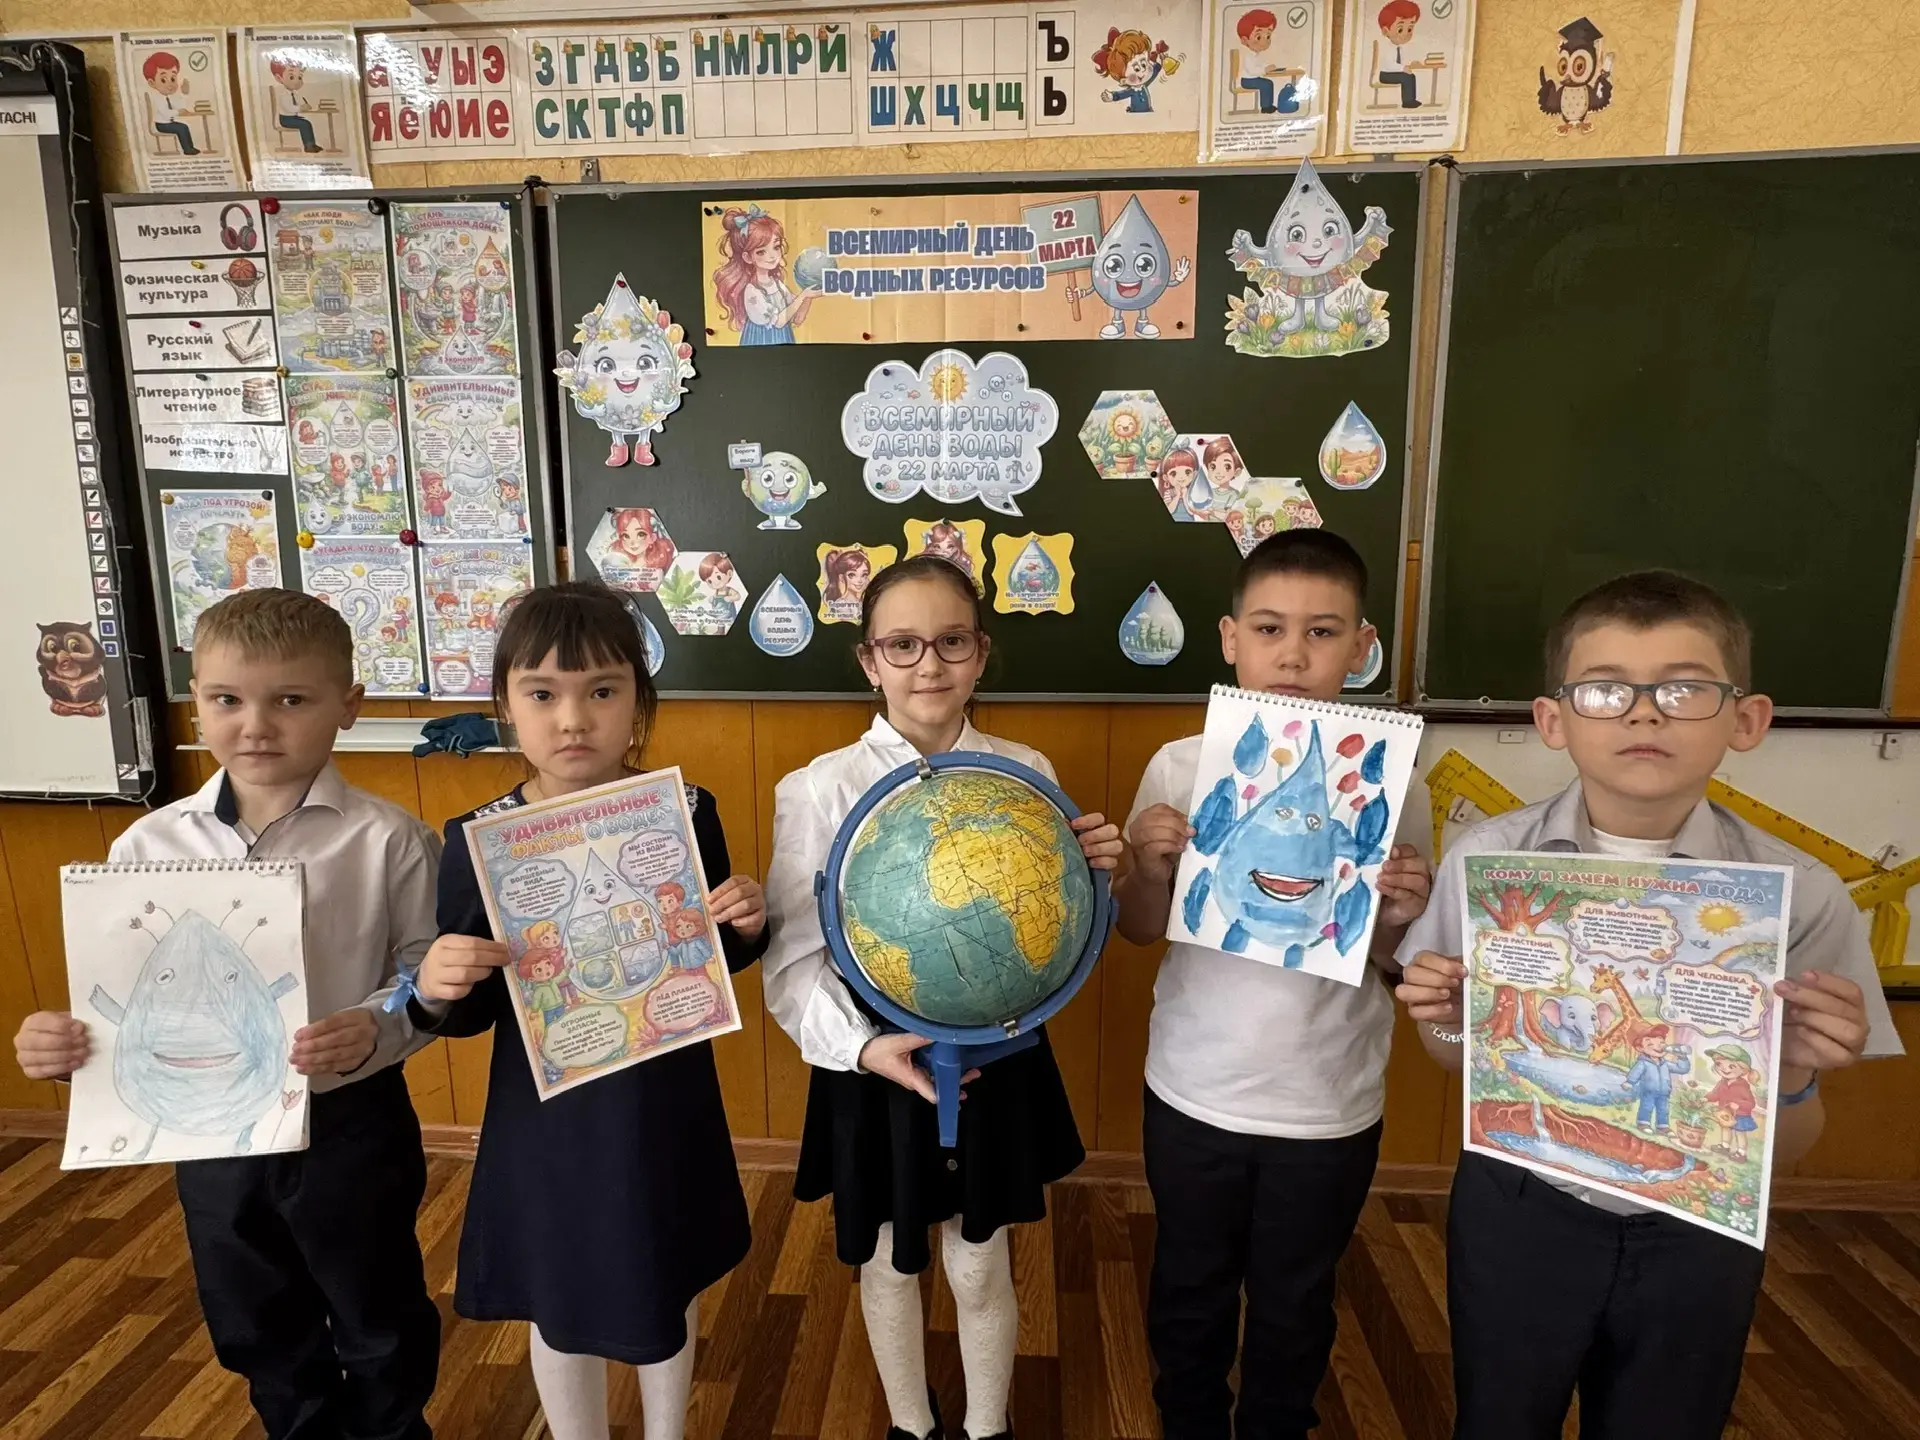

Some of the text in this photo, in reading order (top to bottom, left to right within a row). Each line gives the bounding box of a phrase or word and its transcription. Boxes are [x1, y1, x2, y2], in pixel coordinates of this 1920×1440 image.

[1052, 209, 1074, 230] 22
[138, 224, 202, 240] Музыка
[828, 222, 1035, 256] ВСЕМИРНЫЙ ДЕНЬ
[1038, 236, 1097, 262] МАРТА
[124, 273, 220, 286] Физическая
[824, 264, 1046, 298] ВОДНЫХ РЕСУРСОВ
[139, 290, 208, 304] культура
[147, 332, 213, 348] Русский
[162, 352, 202, 362] язык
[136, 386, 242, 400] Литературное
[164, 402, 217, 412] чтение
[864, 401, 1035, 432] ВСЕМИРНЫЙ
[872, 434, 1023, 460] ДЕНЬ ВОДЫ
[898, 460, 1000, 481] 22 МАРТА
[501, 789, 662, 844] УДИВИТЕЛЬНЫЕ
[511, 826, 586, 861] ФАКТЫ
[586, 822, 604, 841] О
[524, 865, 539, 873] ТРИ
[1484, 869, 1766, 904] КОМУ И ЗАЧЕМ НУЖНА ВОДА
[1675, 968, 1748, 984] ДЛЯ ЧЕЛОВЕКА.
[561, 1010, 602, 1028] ОГРОМНЫЕ
